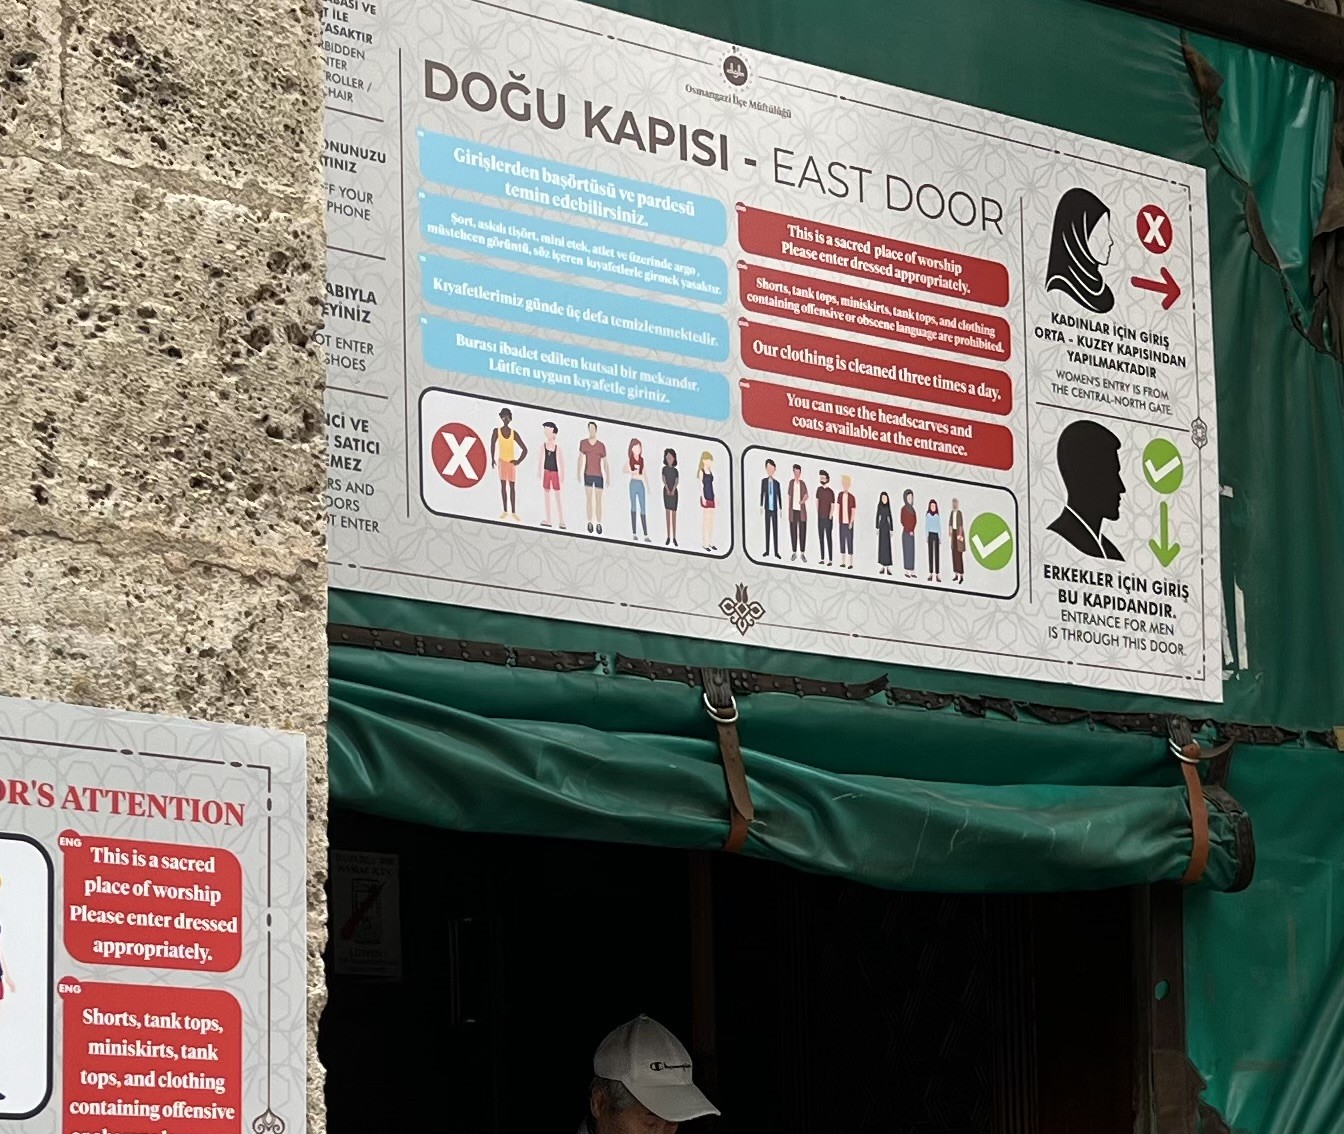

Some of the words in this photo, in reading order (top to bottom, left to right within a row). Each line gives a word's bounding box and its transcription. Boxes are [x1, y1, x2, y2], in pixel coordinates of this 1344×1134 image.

[425, 59, 566, 130] DOĞU
[584, 100, 728, 171] KAPISI
[744, 157, 757, 167] -
[774, 147, 872, 203] EAST
[886, 174, 1003, 235] DOOR
[339, 186, 374, 204] YOUR
[327, 200, 371, 221] PHONE
[1051, 311, 1109, 335] KADINLAR
[1112, 323, 1138, 342] İÇİN
[1140, 329, 1169, 349] GİRİŞ
[336, 337, 374, 355] ENTER
[1034, 326, 1064, 343] ORTA
[1077, 334, 1114, 353] KUZEY
[1116, 343, 1185, 367] KAPISINDAN
[752, 338, 778, 358] Our
[780, 344, 834, 371] clothing
[835, 354, 846, 370] is
[848, 357, 896, 380] cleaned
[898, 366, 930, 386] three
[932, 373, 966, 393] times
[968, 384, 975, 395] a
[977, 381, 1001, 403] day.
[1067, 350, 1156, 378] YAPILMAKTADIR
[1051, 383, 1068, 396] THE
[1070, 386, 1145, 410] CENTRAL-NORTH
[1056, 369, 1100, 387] WOMEN'S
[1103, 378, 1129, 393] ENTRY
[1132, 384, 1140, 395] IS
[1143, 386, 1168, 400] FROM
[334, 434, 379, 454] SATICI
[1043, 564, 1114, 587] ERKEKLER
[1117, 571, 1148, 596] İÇİN
[1152, 576, 1189, 602] GİRİŞ
[1058, 588, 1077, 604] BU
[1083, 592, 1176, 618] KAPIDANDIR.
[1061, 609, 1121, 628] ENTRANCE
[1124, 618, 1145, 632] FOR
[1149, 621, 1173, 636] MEN
[1048, 626, 1058, 638] IS
[1062, 627, 1120, 647] THROUGH
[1123, 636, 1145, 650] THIS
[60, 786, 246, 827] ATTENTION
[90, 846, 129, 865] This
[132, 849, 146, 866] is
[148, 855, 159, 868] a
[161, 856, 215, 873] sacred
[84, 875, 130, 896] place
[132, 879, 152, 896] of
[152, 884, 221, 906] worship
[70, 904, 124, 924] Please
[126, 912, 172, 927] enter
[174, 912, 237, 933] dressed
[93, 940, 212, 964] appropriately.
[83, 1007, 141, 1029] Shorts,
[144, 1012, 182, 1029] tank
[184, 1016, 223, 1034] tops,
[88, 1038, 178, 1060] miniskirts,
[181, 1043, 218, 1060] tank
[80, 1070, 121, 1089] tops,
[124, 1070, 155, 1087] and
[158, 1071, 225, 1094] clothing
[69, 1099, 160, 1121] containing
[162, 1101, 234, 1119] offensive
